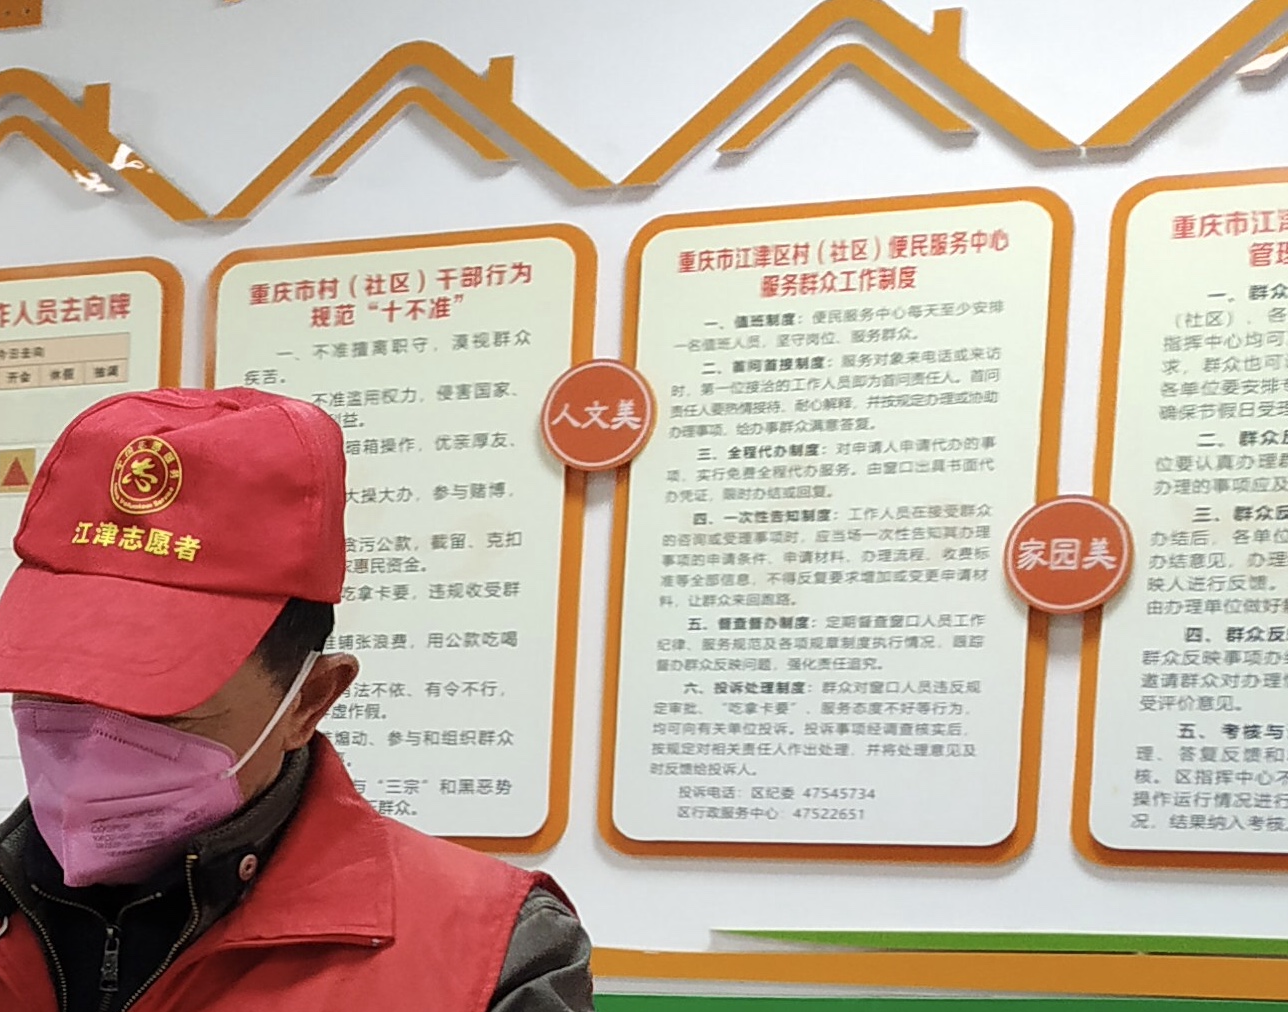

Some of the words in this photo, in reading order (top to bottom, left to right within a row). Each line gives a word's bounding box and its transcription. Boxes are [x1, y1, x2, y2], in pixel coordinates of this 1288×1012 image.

[678, 230, 1009, 273] 重庆市江津区村（社区）便民服务中心
[249, 261, 533, 306] 重庆市村（社区）干部行为
[761, 267, 916, 297] 服务群众工作制度
[310, 294, 464, 328] 规范“十不准”
[1163, 330, 1288, 352] 指挥中心均可
[1162, 353, 1288, 375] 求，群众也可
[1160, 377, 1288, 397] 各单位要安排
[551, 398, 642, 431] 人文美
[72, 521, 202, 562] 江津志愿者
[1016, 537, 1117, 571] 家园美
[1185, 625, 1288, 643] 四、群众反
[1142, 649, 1288, 666] 群众反映事项办
[1141, 672, 1288, 689] 邀请群众对办理
[1177, 722, 1288, 739] 五、考核与
[1136, 745, 1288, 762] 理、答复反馈和
[803, 787, 876, 800] 47545734
[793, 807, 865, 820] 47522651
